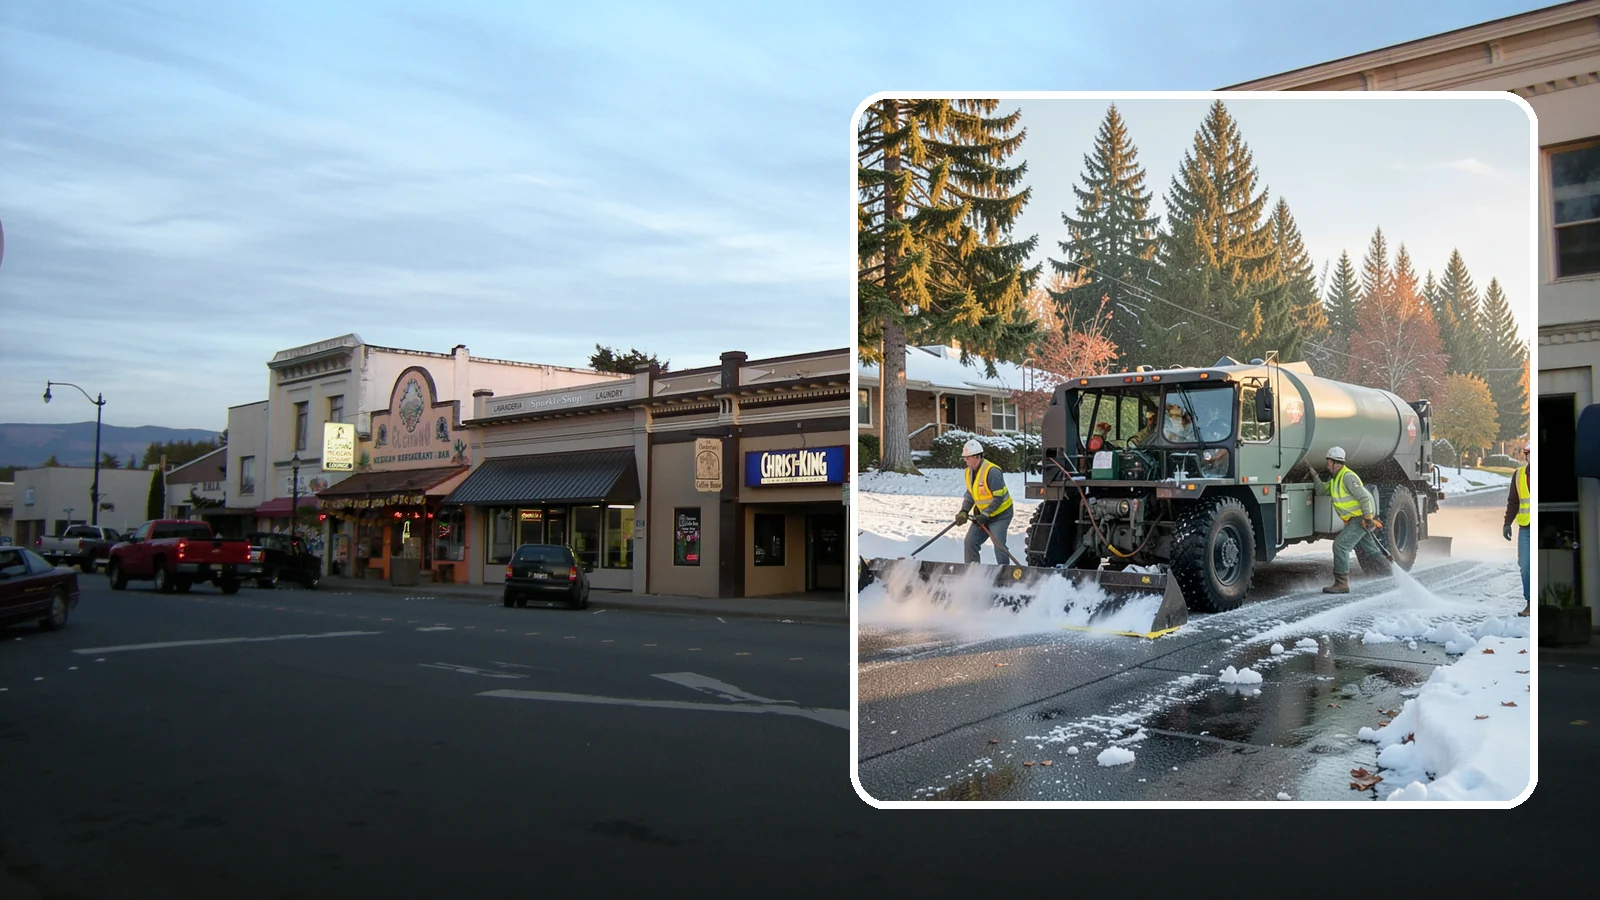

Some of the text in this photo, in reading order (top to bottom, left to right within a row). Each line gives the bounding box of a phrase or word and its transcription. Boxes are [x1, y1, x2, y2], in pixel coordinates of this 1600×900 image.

[493, 402, 523, 413] LAVANDERIA
[561, 394, 583, 406] Shop
[595, 388, 624, 400] LAUNDRY
[397, 451, 433, 463] RESTAURANT
[438, 450, 451, 461] BAR
[761, 450, 827, 478] CHRIST KING
